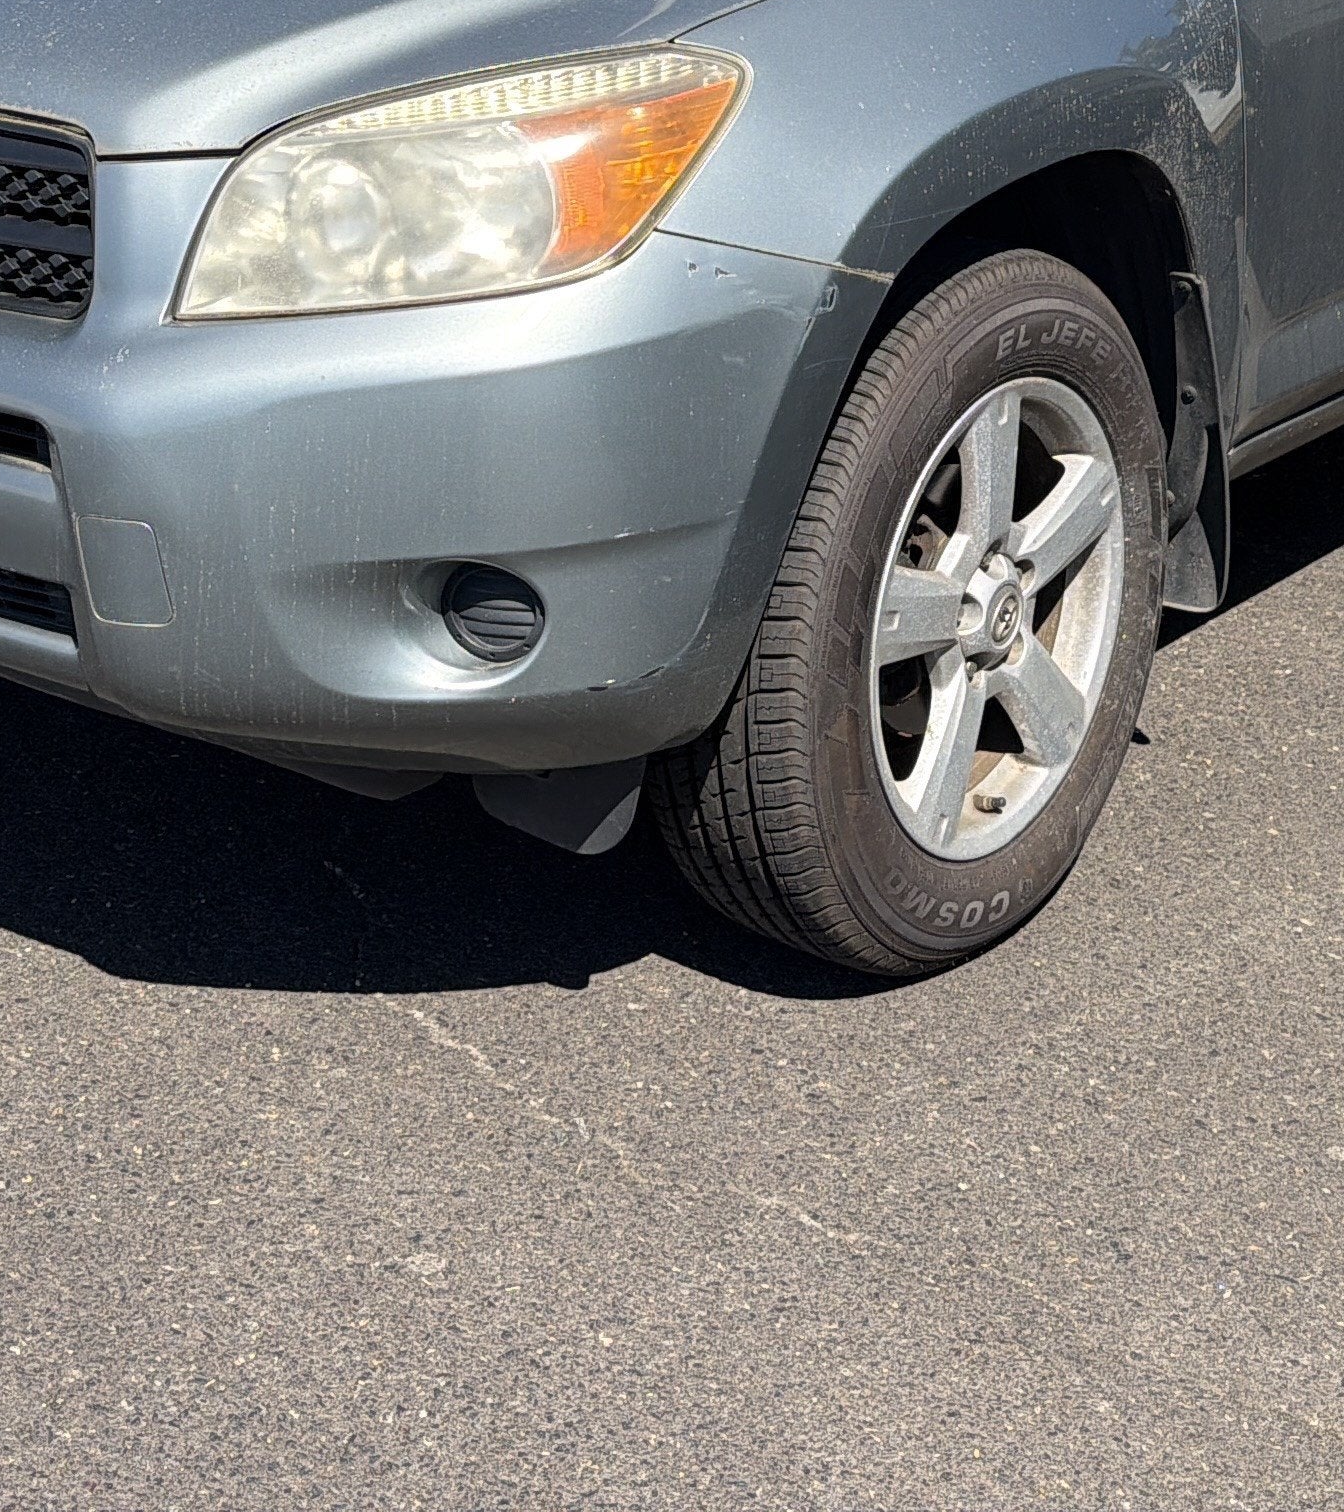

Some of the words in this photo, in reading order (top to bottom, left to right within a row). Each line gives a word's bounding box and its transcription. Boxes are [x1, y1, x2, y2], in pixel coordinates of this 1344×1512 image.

[995, 324, 1033, 362] EL
[1040, 318, 1114, 366] JEFE
[882, 866, 1011, 929] COSMO
